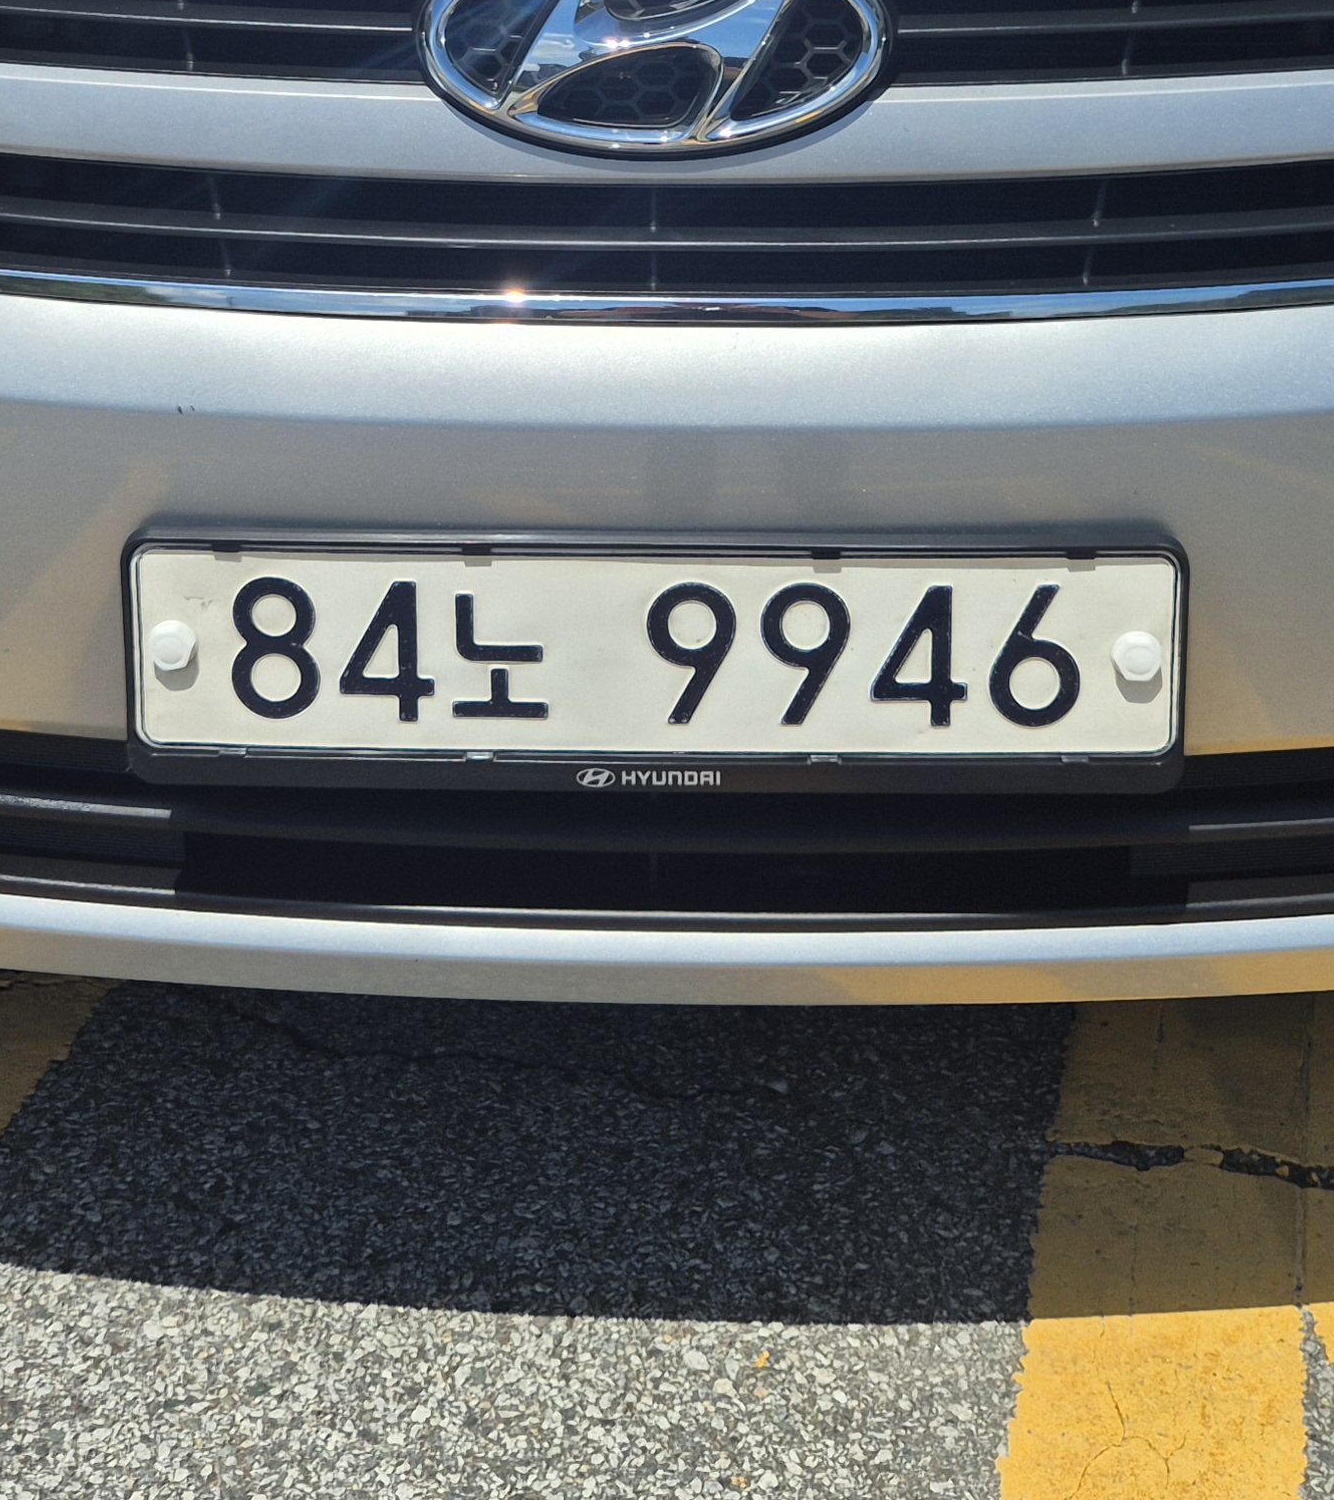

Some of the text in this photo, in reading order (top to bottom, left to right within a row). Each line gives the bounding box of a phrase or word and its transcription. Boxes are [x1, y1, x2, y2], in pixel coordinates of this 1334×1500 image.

[231, 576, 1081, 728] 84노 9946
[621, 770, 721, 786] HYUNDAI
